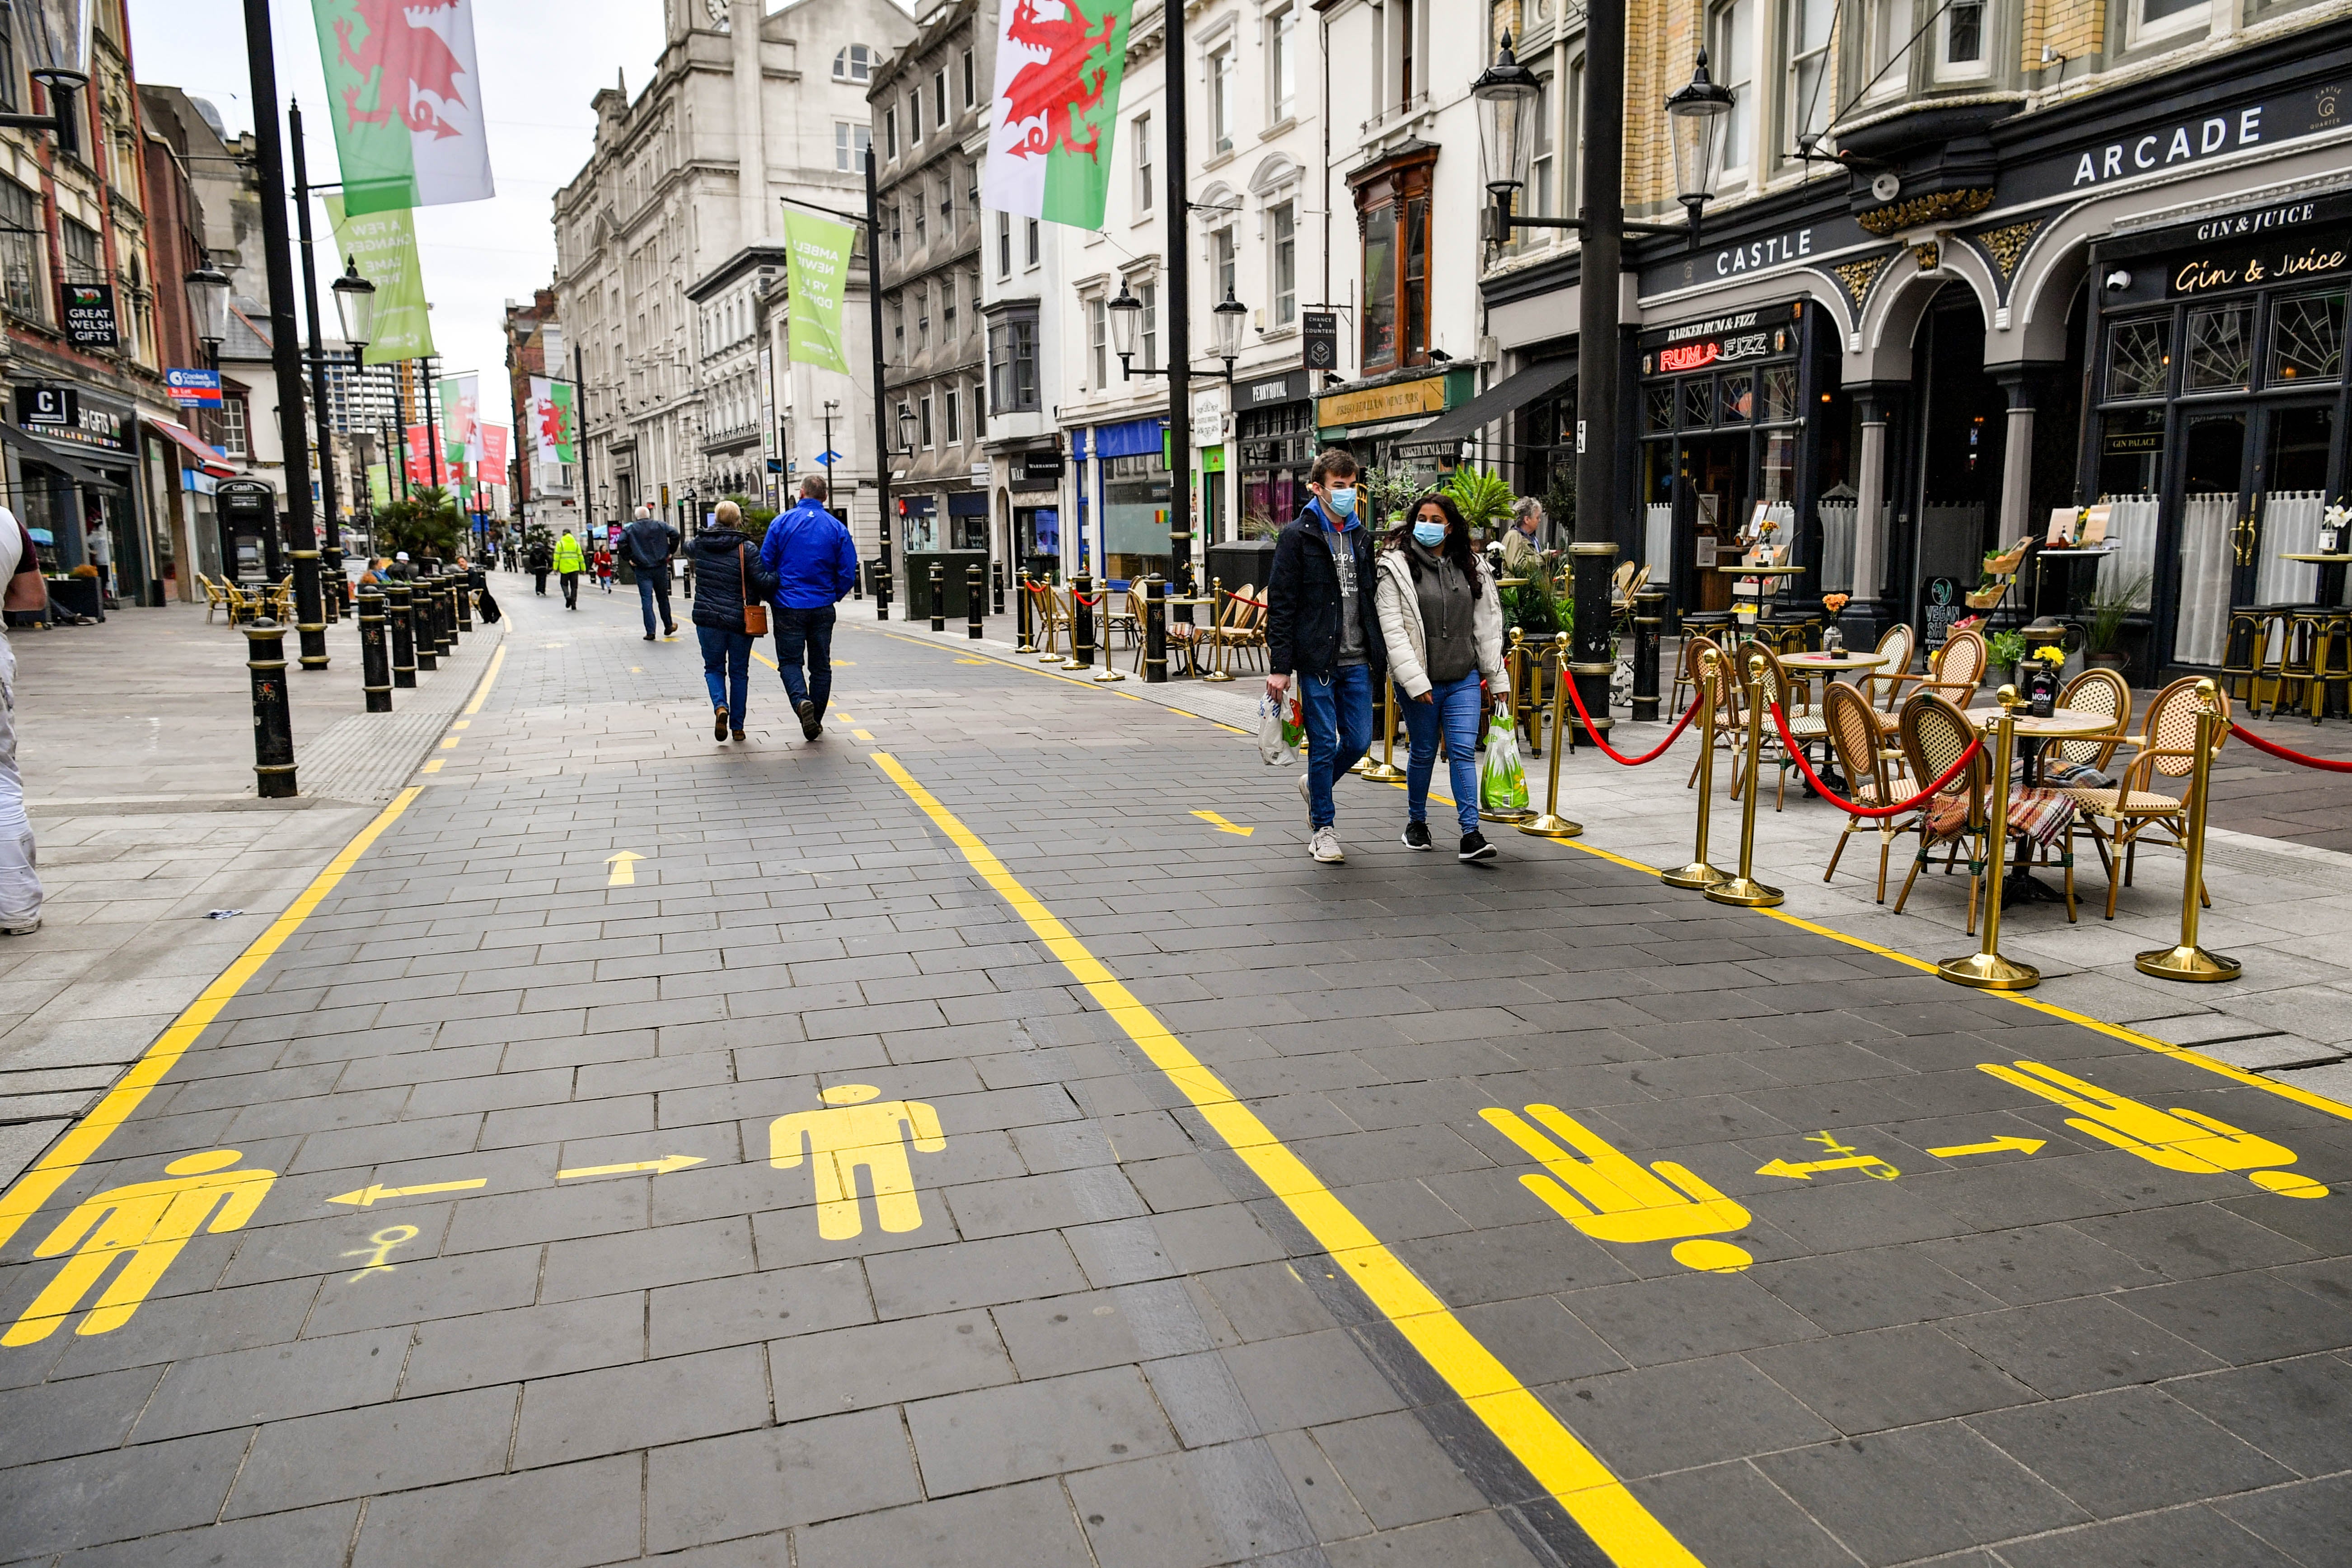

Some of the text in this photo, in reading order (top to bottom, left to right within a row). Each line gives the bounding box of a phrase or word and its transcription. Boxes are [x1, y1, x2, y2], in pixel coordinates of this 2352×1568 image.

[2073, 107, 2262, 186] ARCADE
[2197, 203, 2314, 240] GIN & JUICE
[1717, 229, 1811, 275] CASTLE
[2176, 248, 2347, 293] Gin & Juice
[69, 309, 110, 318] GREAT
[68, 319, 115, 330] WELSH
[1667, 312, 1757, 342] BARKER RUM & FIZZ
[75, 331, 111, 341] GIFTS
[1660, 332, 1767, 372] RUM & FIZZ
[1252, 380, 1287, 402] PENNYROYAL
[1386, 393, 1403, 405] WINE
[1405, 392, 1419, 404] BAR
[38, 391, 54, 412] C
[89, 409, 110, 435] GIFTS
[1399, 442, 1455, 459] BARKER RUM & FIZZ
[2128, 438, 2156, 447] PALACE
[1925, 605, 1960, 623] VEGAN
[1927, 622, 1949, 639] SHO
[2032, 693, 2051, 701] MOM
